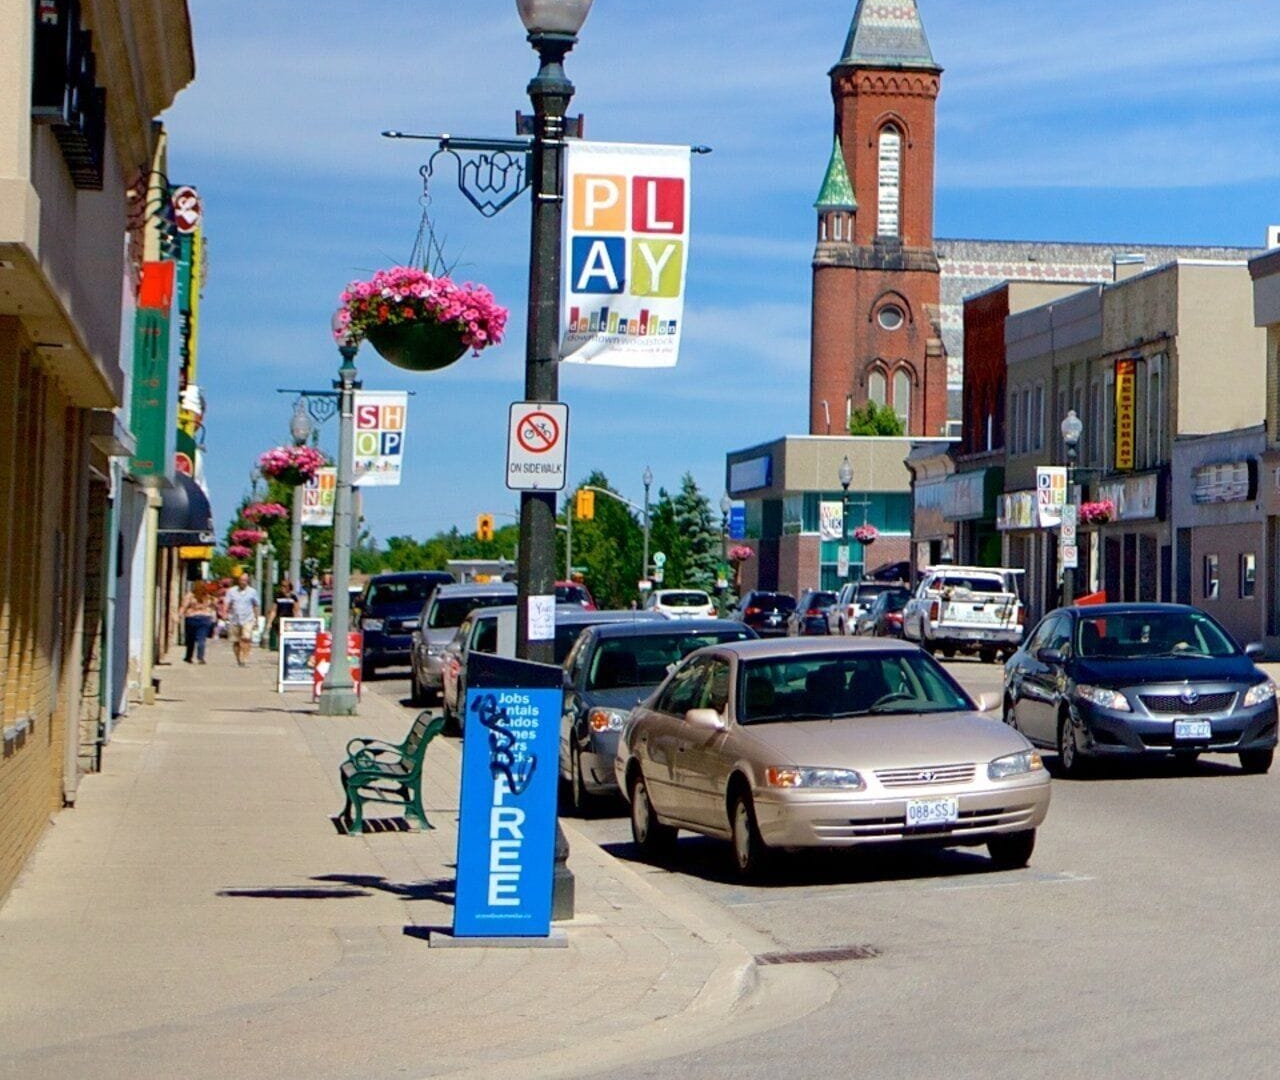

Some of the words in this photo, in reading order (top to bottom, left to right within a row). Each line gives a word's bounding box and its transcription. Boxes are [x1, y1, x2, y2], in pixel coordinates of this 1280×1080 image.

[510, 462, 522, 474] ON
[523, 462, 563, 474] SIDEWALK
[499, 693, 530, 704] Jobs
[488, 772, 526, 907] FREE
